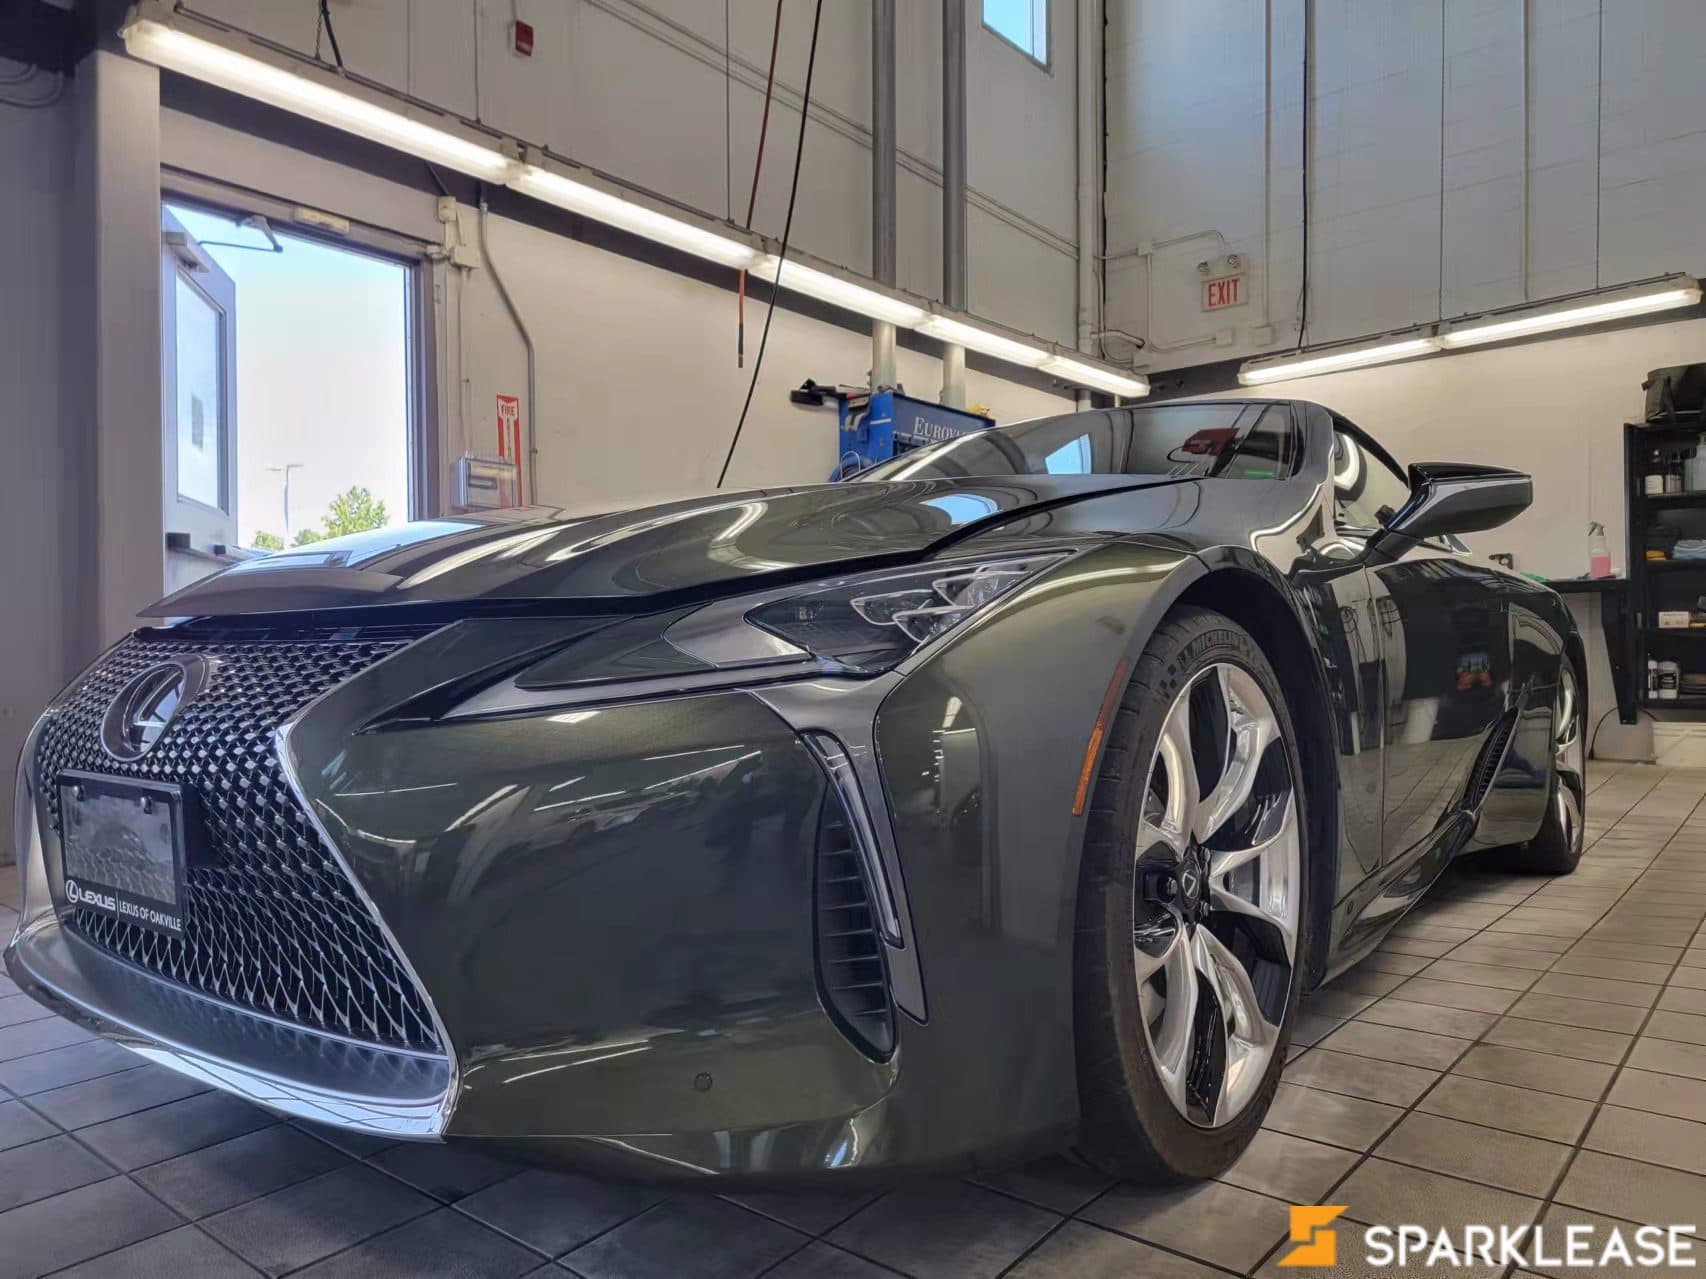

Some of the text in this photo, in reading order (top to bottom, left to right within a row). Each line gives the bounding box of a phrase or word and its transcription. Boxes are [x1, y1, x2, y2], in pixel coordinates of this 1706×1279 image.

[1207, 278, 1240, 308] EXIT
[501, 404, 516, 417] FIRE
[79, 887, 116, 911] LEXUS
[119, 901, 182, 932] LEXUS OF OAKVILLE
